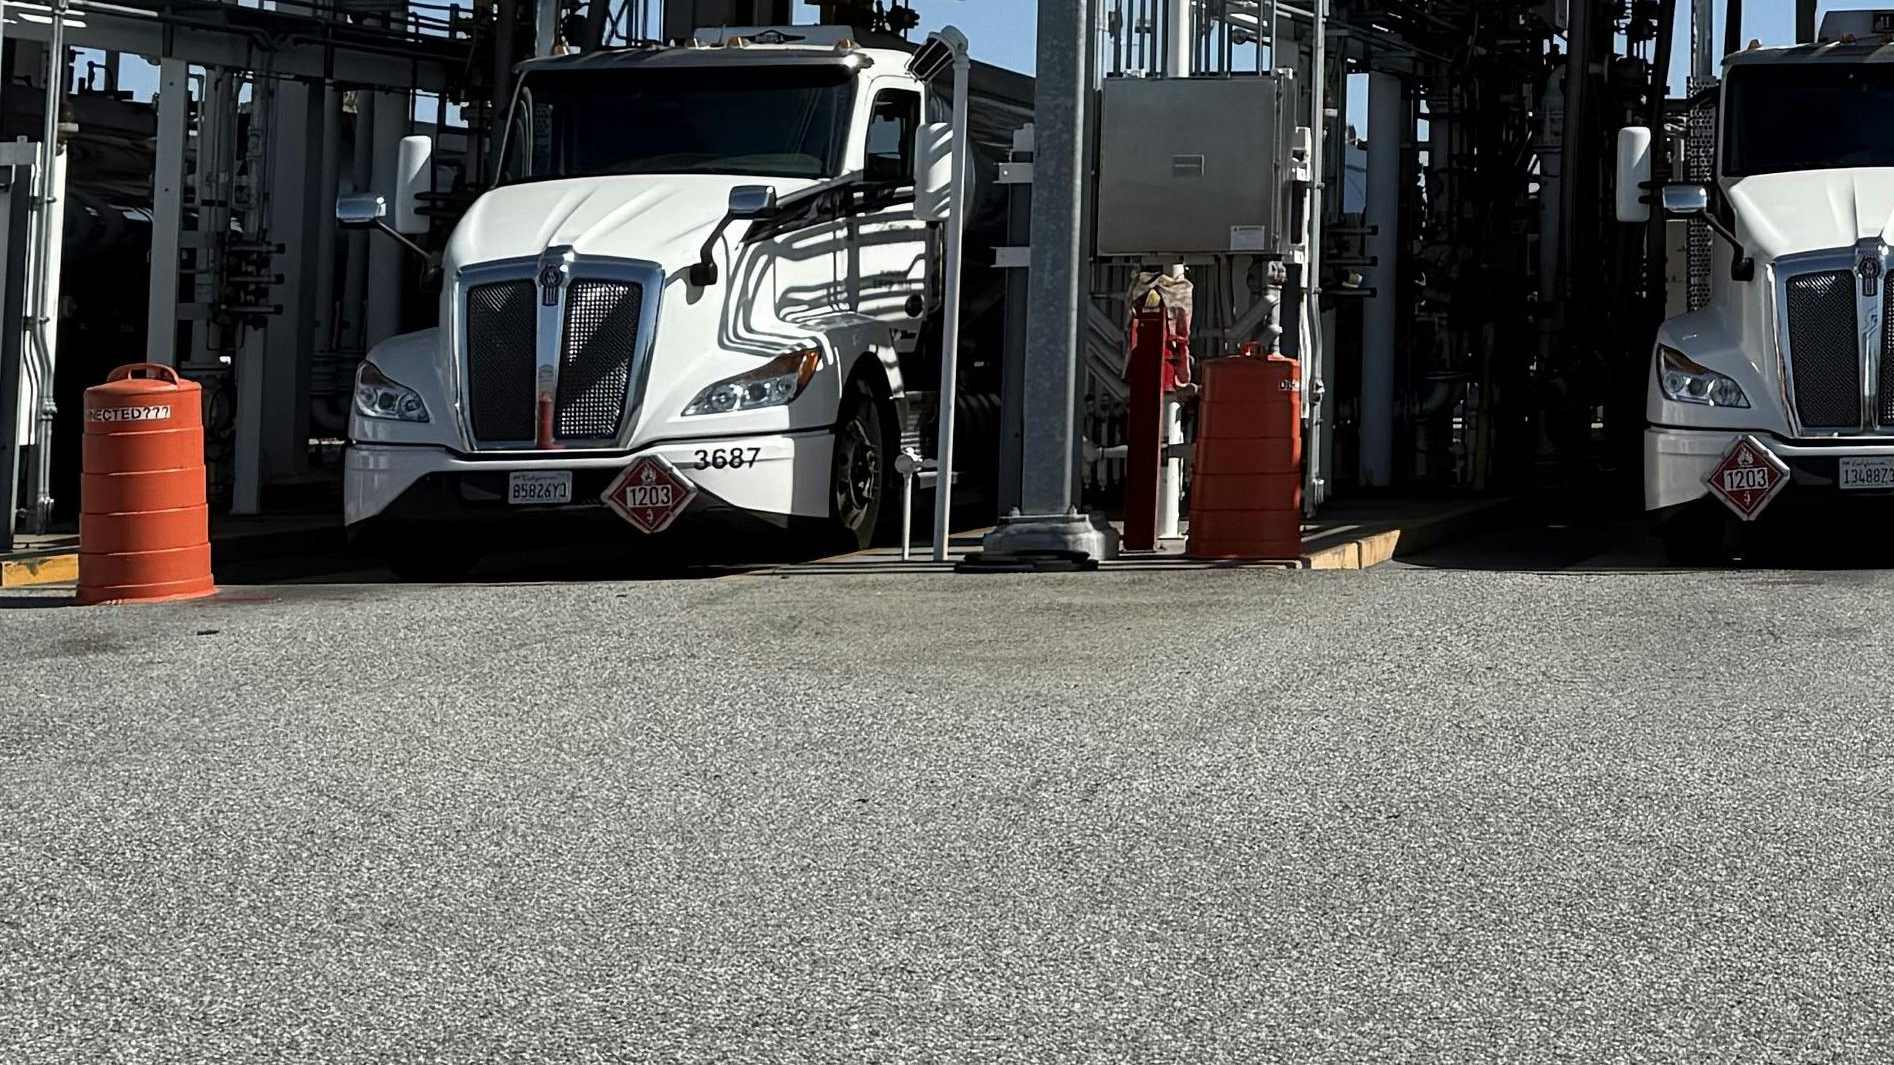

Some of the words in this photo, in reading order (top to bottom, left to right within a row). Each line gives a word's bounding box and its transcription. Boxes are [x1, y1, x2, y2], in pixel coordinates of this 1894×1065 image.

[693, 447, 761, 470] 3687
[1727, 468, 1768, 489] 1203
[629, 486, 671, 506] 1203
[1743, 490, 1752, 505] 3
